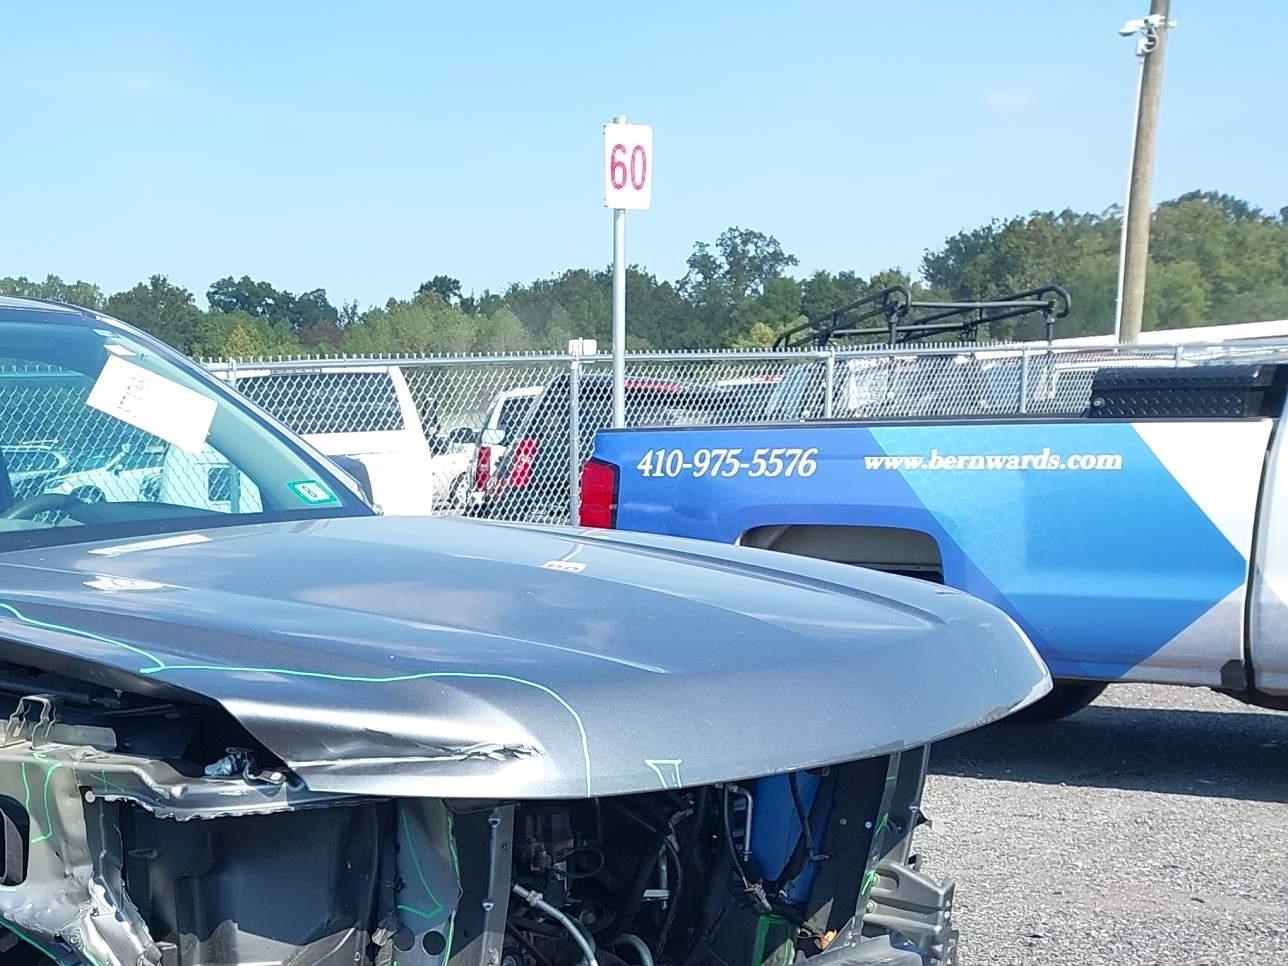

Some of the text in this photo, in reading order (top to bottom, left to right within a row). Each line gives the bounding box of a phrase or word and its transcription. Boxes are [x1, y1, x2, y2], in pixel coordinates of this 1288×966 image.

[610, 143, 647, 190] 60
[637, 448, 818, 477] 410-975-5576
[864, 448, 1123, 470] www.bernwards.com
